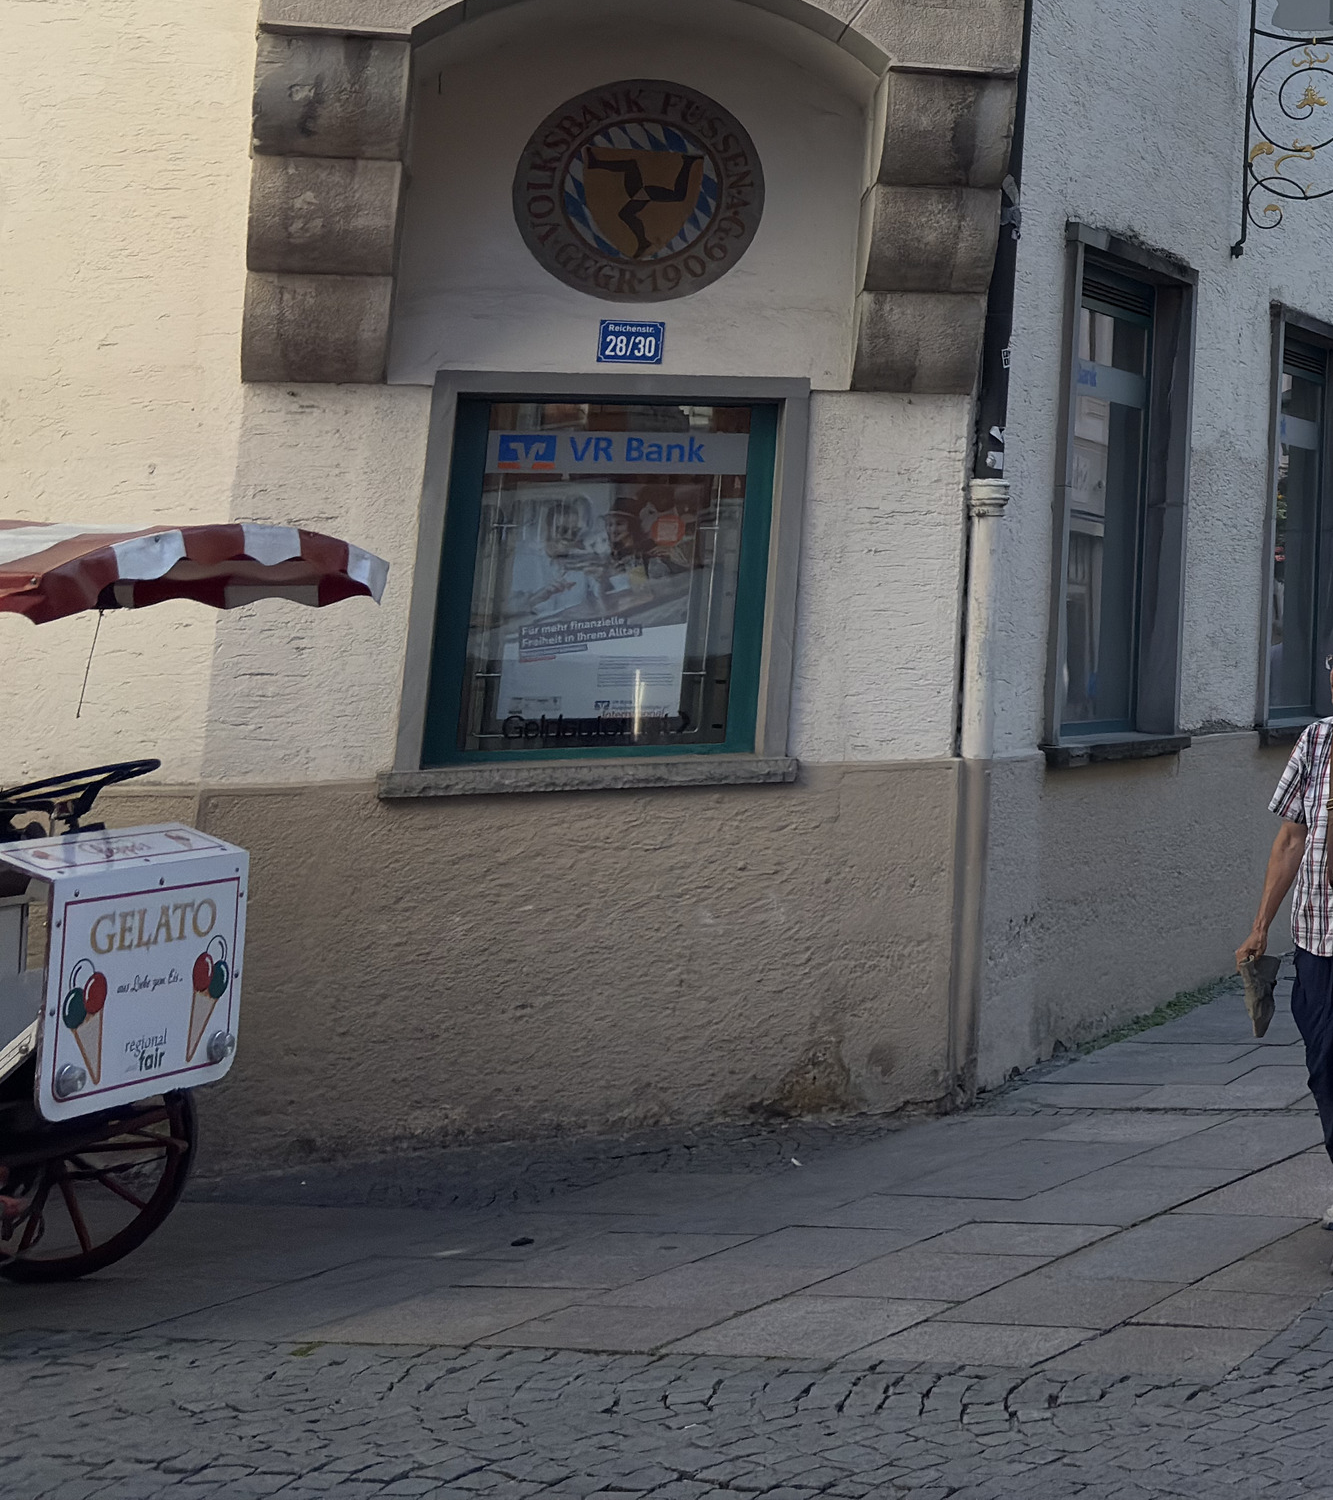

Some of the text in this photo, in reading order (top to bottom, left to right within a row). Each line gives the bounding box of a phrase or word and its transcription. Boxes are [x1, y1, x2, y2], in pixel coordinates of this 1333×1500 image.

[526, 88, 646, 246] VOLKSBANK
[608, 323, 655, 334] Reichenstr.
[605, 336, 656, 357] 28/30
[570, 436, 704, 463] VR Bank
[521, 617, 626, 636] Für mehr finanzielle
[521, 626, 641, 648] Freiheit in Ihrem Alltag
[90, 898, 218, 955] GELATO
[124, 1029, 168, 1058] regional
[137, 1048, 166, 1072] fair
